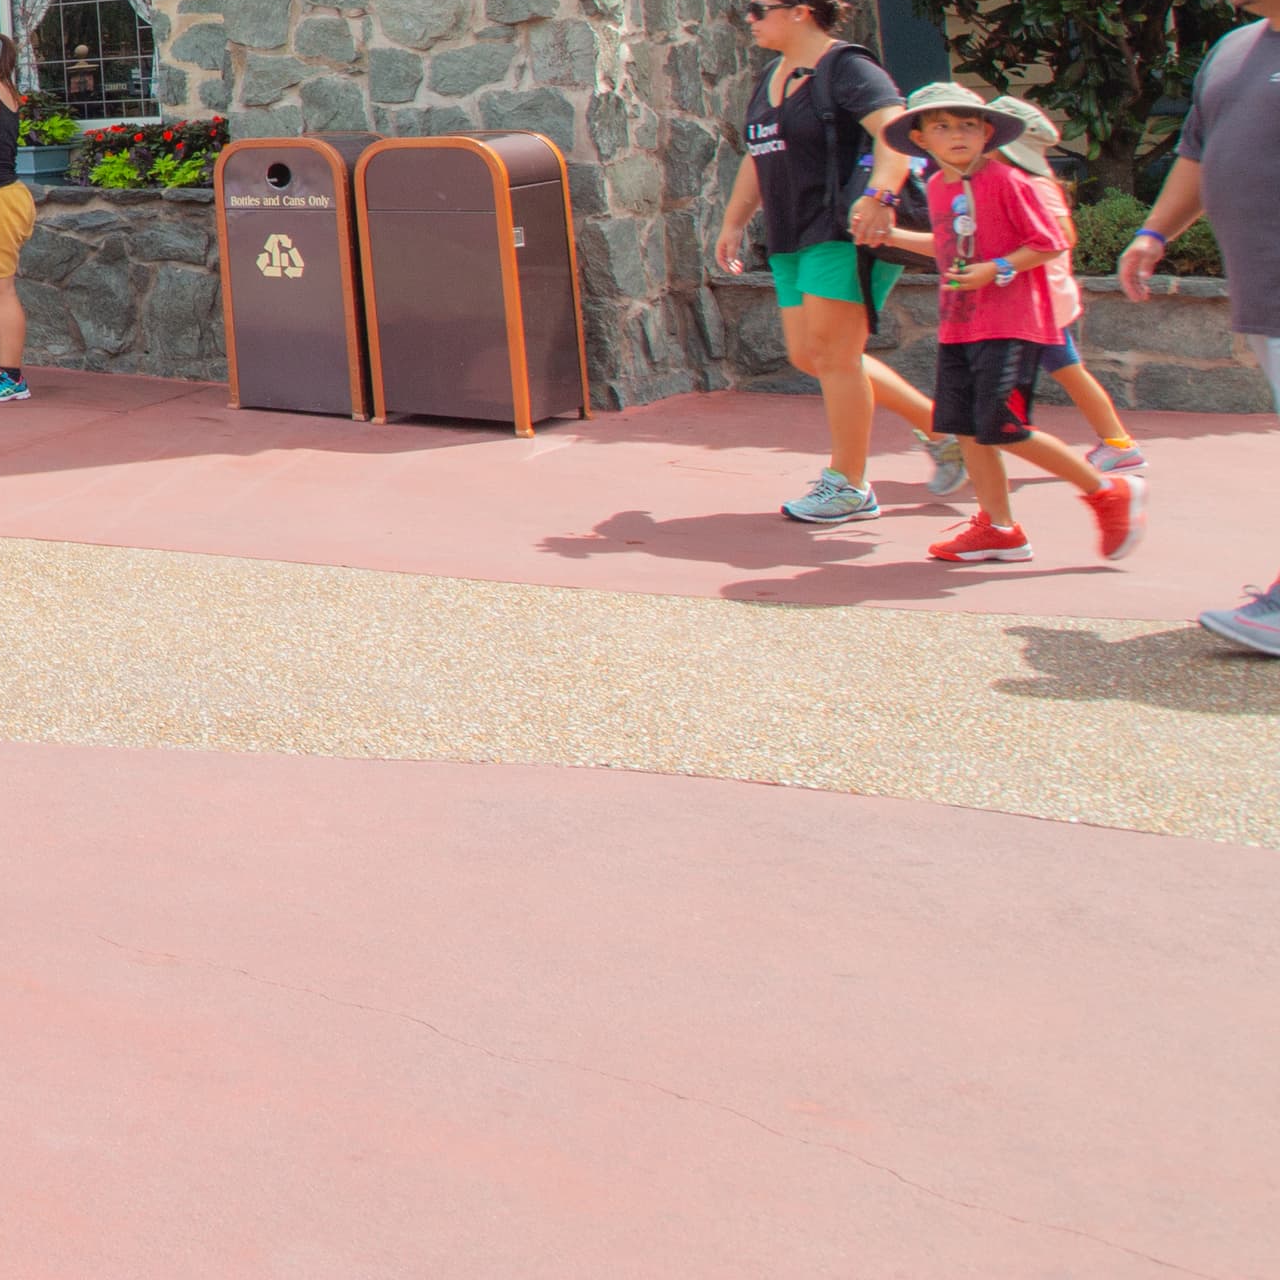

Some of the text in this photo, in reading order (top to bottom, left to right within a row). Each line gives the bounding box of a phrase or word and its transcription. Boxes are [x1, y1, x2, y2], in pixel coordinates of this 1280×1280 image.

[230, 195, 330, 208] Bottles and Cans Only
